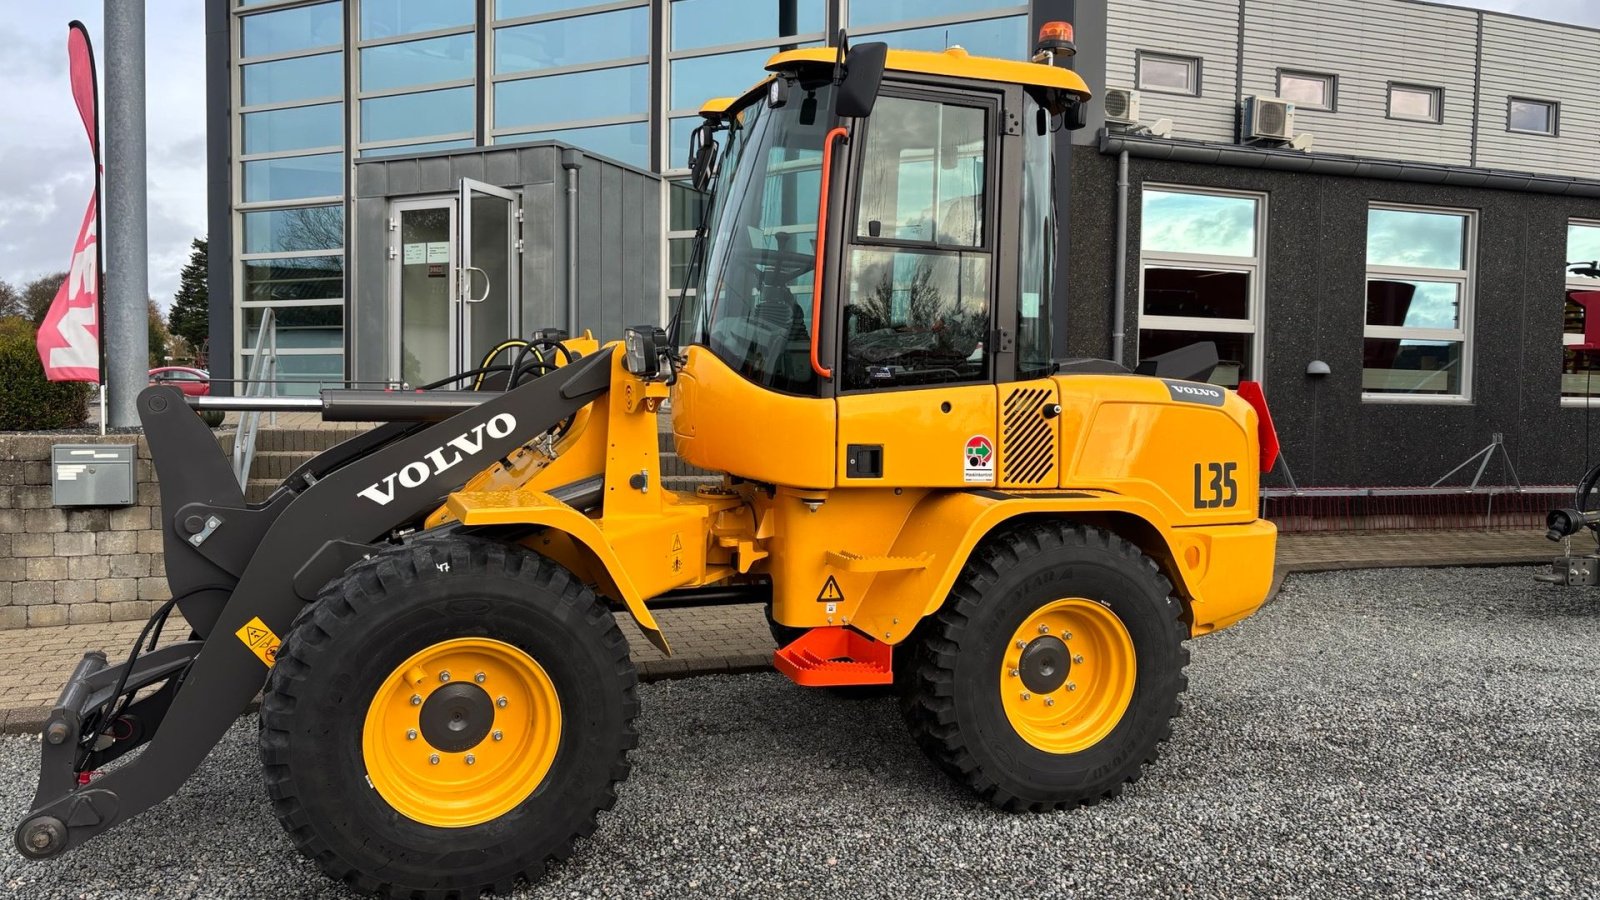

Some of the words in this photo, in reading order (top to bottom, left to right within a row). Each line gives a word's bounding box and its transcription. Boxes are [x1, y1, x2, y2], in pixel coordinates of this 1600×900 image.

[1171, 385, 1219, 398] VOLVO
[357, 413, 517, 506] VOLVO
[1194, 462, 1237, 509] L35
